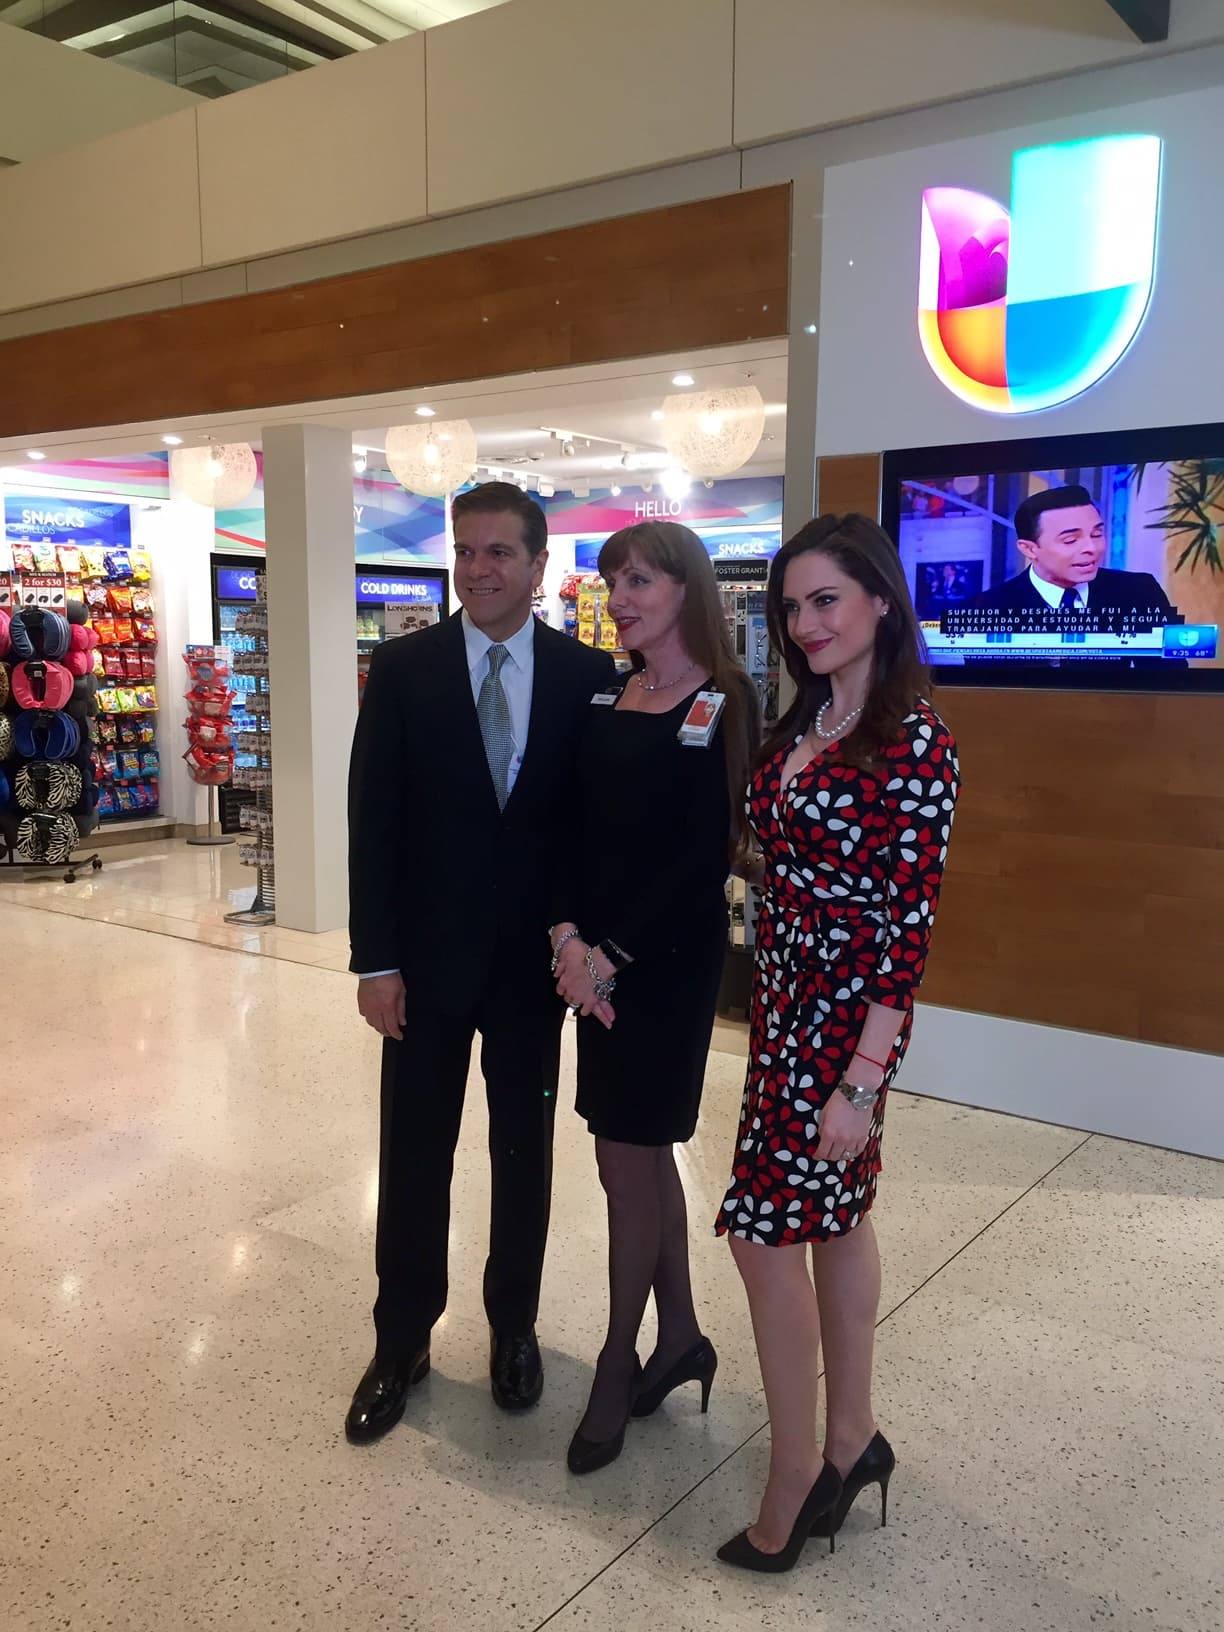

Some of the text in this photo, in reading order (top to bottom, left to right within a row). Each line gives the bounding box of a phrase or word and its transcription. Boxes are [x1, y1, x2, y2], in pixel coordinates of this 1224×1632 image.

[634, 499, 682, 518] HELLO
[22, 508, 85, 528] SNACKS
[718, 543, 765, 555] SNACKS
[741, 567, 763, 575] GRANT
[24, 578, 62, 587] 2 for $30
[361, 582, 427, 596] COLD DRINKS
[947, 608, 1000, 616] SUPERIOR
[947, 617, 1020, 625] UNIVERSIDAD
[947, 625, 1013, 633] TRABAJANDO
